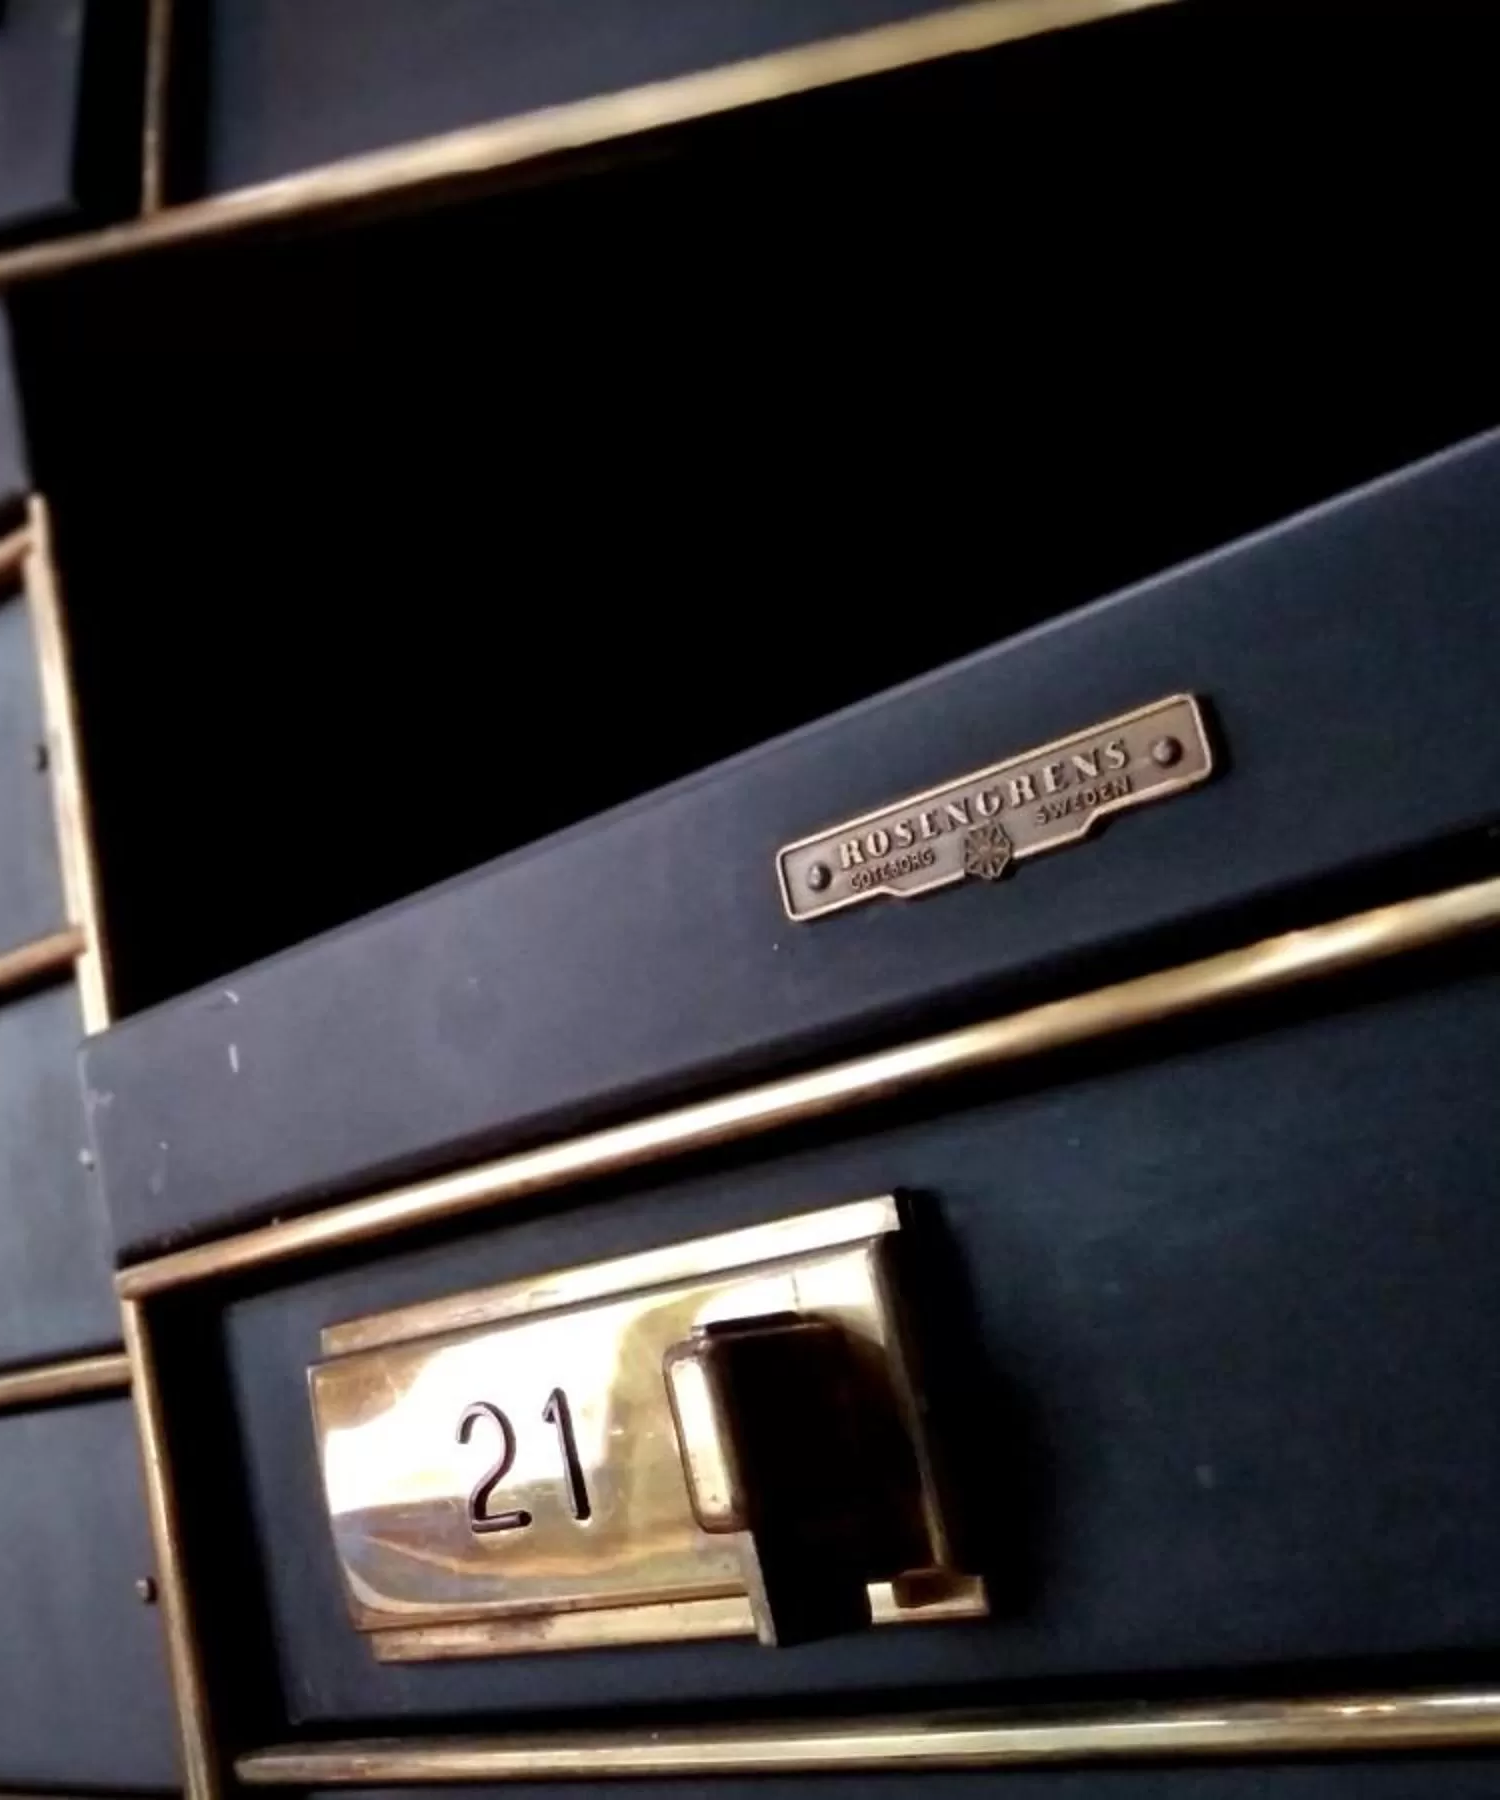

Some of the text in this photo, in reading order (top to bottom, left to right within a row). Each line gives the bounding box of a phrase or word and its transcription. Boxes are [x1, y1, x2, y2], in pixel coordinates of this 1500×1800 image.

[838, 739, 1130, 871] ROSENGRENS
[1034, 775, 1133, 826] SWEDEN
[456, 1387, 592, 1533] 21
